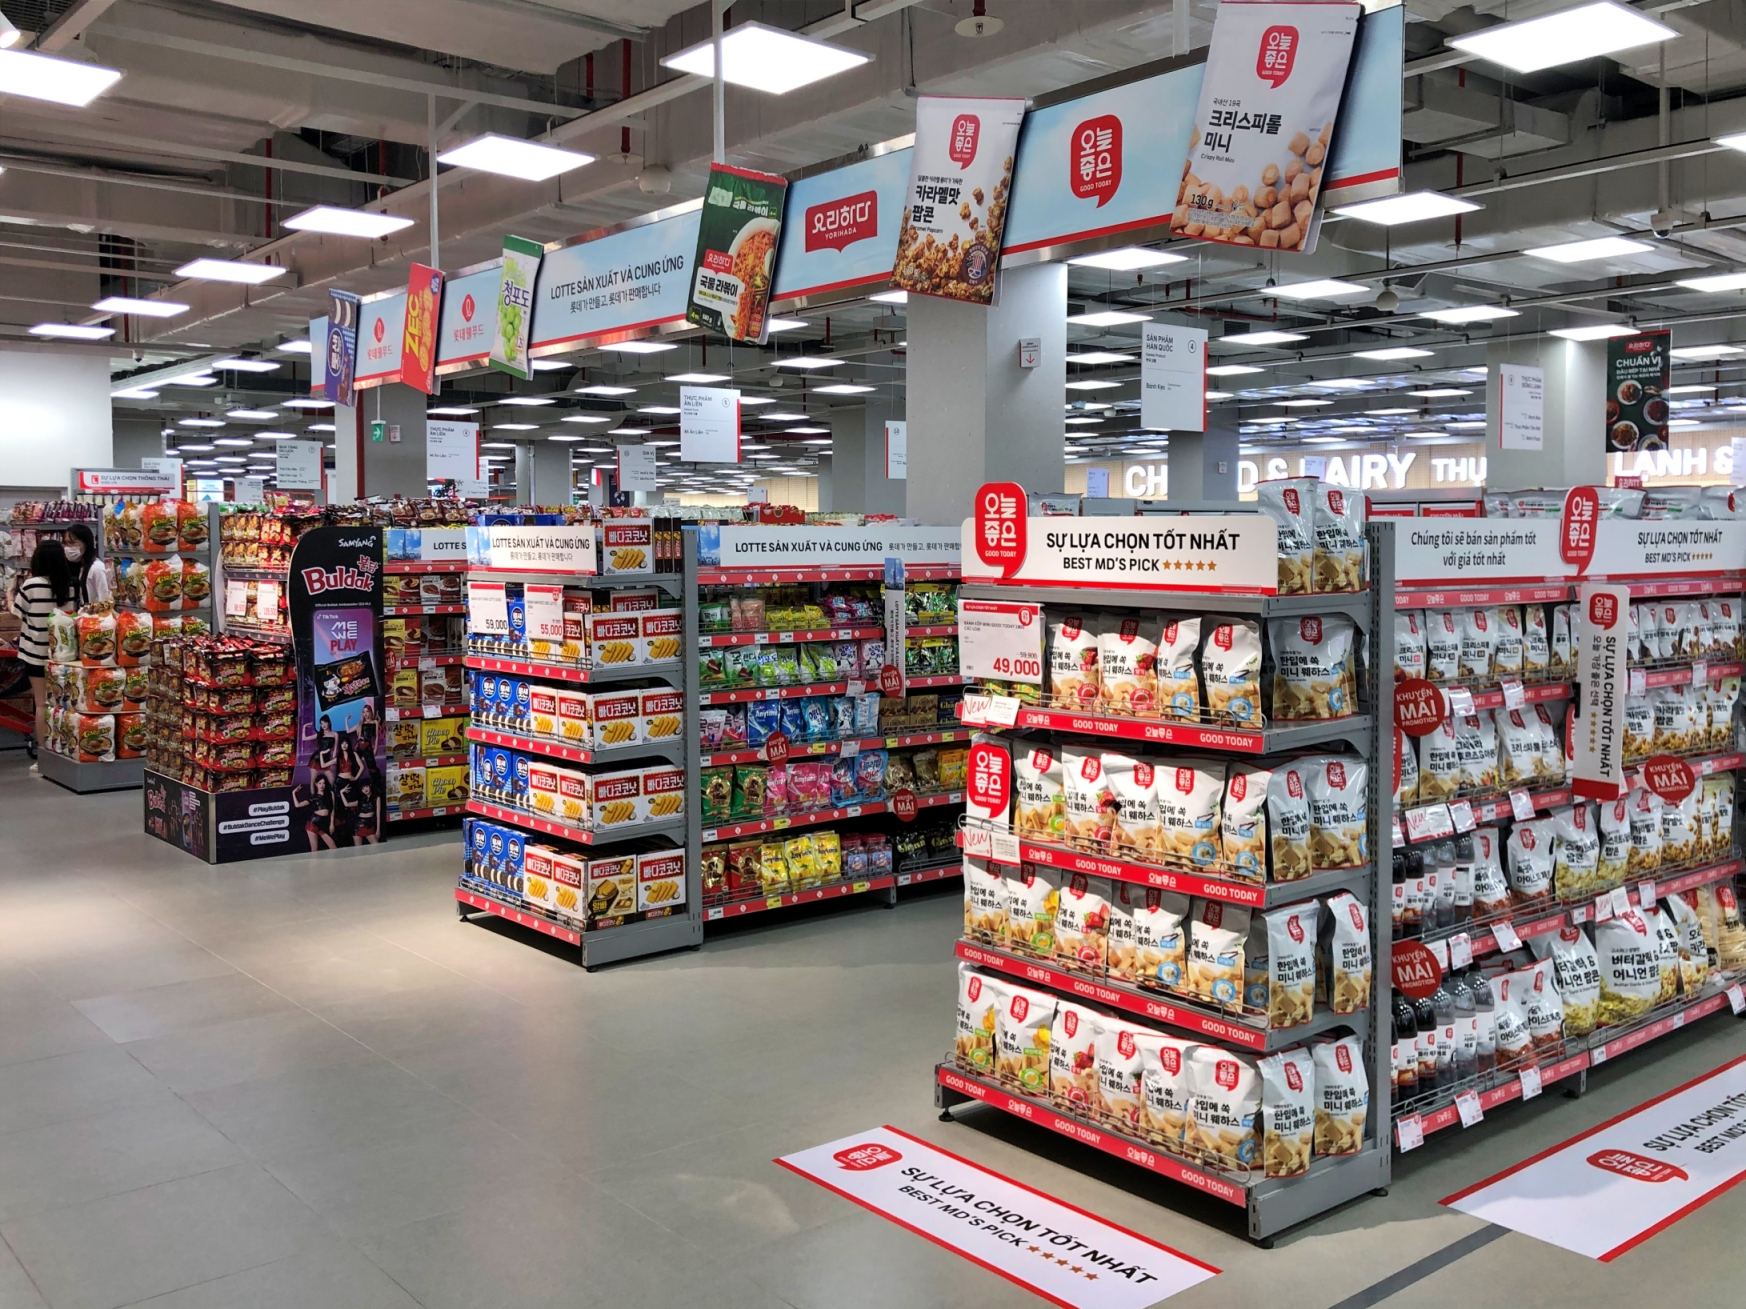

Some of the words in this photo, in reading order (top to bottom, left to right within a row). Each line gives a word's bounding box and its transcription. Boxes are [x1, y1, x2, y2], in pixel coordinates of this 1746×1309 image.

[1268, 32, 1293, 50] 오늘
[1264, 50, 1288, 69] 좋은
[1213, 97, 1228, 107] 국내산
[956, 120, 975, 136] 오늘
[1208, 109, 1282, 135] 크리스피롤
[955, 136, 972, 152] 좋은
[1081, 127, 1112, 155] 오늘
[1204, 132, 1232, 153] 미니
[1201, 152, 1214, 162] Crispy
[1079, 151, 1112, 181] 좋은
[1080, 182, 1094, 192] GOOD
[1095, 179, 1112, 189] TODAY
[915, 185, 960, 206] 카라멜맛
[812, 200, 871, 234] 요리하다
[912, 205, 934, 224] 팝콘
[825, 228, 857, 240] YORIHADA
[550, 282, 576, 300] LOTTE
[576, 275, 594, 294] SẢN
[595, 268, 620, 289] XUẤT
[620, 264, 634, 282] VÀ
[634, 261, 662, 280] CUNG
[662, 254, 684, 275] ỨNG
[502, 280, 530, 308] 청포도
[700, 275, 715, 291] 국물
[715, 277, 738, 297] 라볶이
[570, 300, 588, 314] 롯데가
[588, 295, 608, 310] 만들고,
[608, 290, 628, 306] 롯데가
[628, 282, 661, 302] 판매합니다
[405, 293, 420, 358] ZEC
[454, 324, 484, 342] 롯데웰푸드
[1146, 333, 1158, 342] SẢN
[1158, 335, 1174, 344] PHẨM
[1158, 344, 1174, 352] QUỐC
[1616, 356, 1650, 368] CHUẨN
[1615, 448, 1707, 481] LẠNH
[985, 493, 1016, 518] 오늘
[1572, 496, 1593, 520] 오늘
[338, 536, 376, 548] SAMYANG
[608, 530, 648, 544] 빠다코코낫
[985, 520, 1016, 548] 좋은
[1046, 532, 1068, 552] SỰ
[1070, 532, 1101, 554] LỰA
[1104, 533, 1150, 554] CHỌN
[1152, 528, 1186, 550] TỐT
[1190, 528, 1240, 550] NHẤT
[1411, 531, 1440, 548] Chúng
[1441, 531, 1454, 546] tôi
[1454, 533, 1465, 546] sẽ
[1466, 531, 1483, 546] bán
[1484, 532, 1498, 546] sản
[1500, 532, 1524, 548] phẩm
[1524, 531, 1536, 546] tốt
[1571, 522, 1590, 547] 좋은
[1638, 531, 1652, 547] SỰ
[1652, 531, 1667, 546] LỰA
[1668, 532, 1689, 546] CHỌN
[1690, 528, 1703, 545] TỐT
[1703, 528, 1722, 544] NHẤT
[492, 537, 512, 548] LOTTE
[512, 536, 526, 549] SẢN
[527, 536, 544, 549] XUẤT
[544, 536, 554, 550] VÀ
[554, 538, 574, 550] CUNG
[574, 536, 590, 550] ỨNG
[736, 542, 767, 552] LOTTE
[769, 540, 789, 552] SẢN
[791, 540, 818, 552] XUẤT
[820, 540, 833, 552] VÀ
[834, 542, 861, 552] CUNG
[862, 540, 882, 552] ỨNG
[985, 550, 999, 558] GOOD
[1443, 551, 1457, 566] với
[1458, 552, 1471, 568] giá
[1472, 552, 1485, 566] tốt
[1486, 551, 1506, 566] nhất
[1645, 552, 1660, 564] BEST
[1661, 552, 1677, 562] MD'S
[1678, 552, 1691, 562] PICK
[357, 554, 379, 574] 불닭
[1064, 556, 1093, 570] BEST
[1096, 556, 1128, 571] MD'S
[1129, 558, 1160, 572] PICK
[301, 566, 375, 596] Buldak
[486, 618, 508, 630] 59,000
[540, 624, 562, 636] 55,000
[597, 624, 636, 638] 빠다코코낫
[330, 640, 358, 651] PLAY
[1605, 636, 1616, 654] SỰ
[993, 657, 1040, 677] 49,000
[1280, 656, 1308, 666] 한입에
[1310, 656, 1320, 666] 쏙
[1604, 654, 1616, 679] LỰA
[1280, 668, 1299, 678] 미니
[1301, 668, 1330, 677] 웨하스
[1396, 688, 1433, 702] KHUYẾN
[1602, 684, 1614, 714] CHỌN
[756, 709, 778, 718] Anytime
[964, 697, 988, 716] New
[1400, 697, 1437, 720] MÃI
[1026, 714, 1050, 726] 오늘좋은
[1073, 720, 1094, 730] GOOD
[1094, 722, 1118, 732] TODAY
[1402, 716, 1438, 727] PROMOTION
[1602, 715, 1614, 740] TỐT
[425, 729, 449, 738] Choco
[425, 736, 440, 746] Pie
[770, 743, 786, 756] MÃI
[1600, 742, 1613, 777] NHẤT
[253, 804, 285, 814] #PlayBuldak
[222, 818, 286, 832] #BuldakDanceChallenge
[254, 832, 286, 842] #MeWePlay
[1611, 952, 1652, 966] 버터갈릭
[1613, 967, 1647, 980] 어니언
[946, 1075, 964, 1089] GOOD
[964, 1082, 986, 1098] TODAY
[1690, 1105, 1738, 1126] CHỌN
[898, 1185, 941, 1207] BEST
[938, 1203, 985, 1228] MD'S
[981, 1222, 1028, 1249] PICK
[929, 1179, 975, 1204] LỰA
[973, 1199, 1040, 1234] CHỌN
[1039, 1226, 1089, 1254] TỐT
[1083, 1248, 1159, 1285] NHẤT
